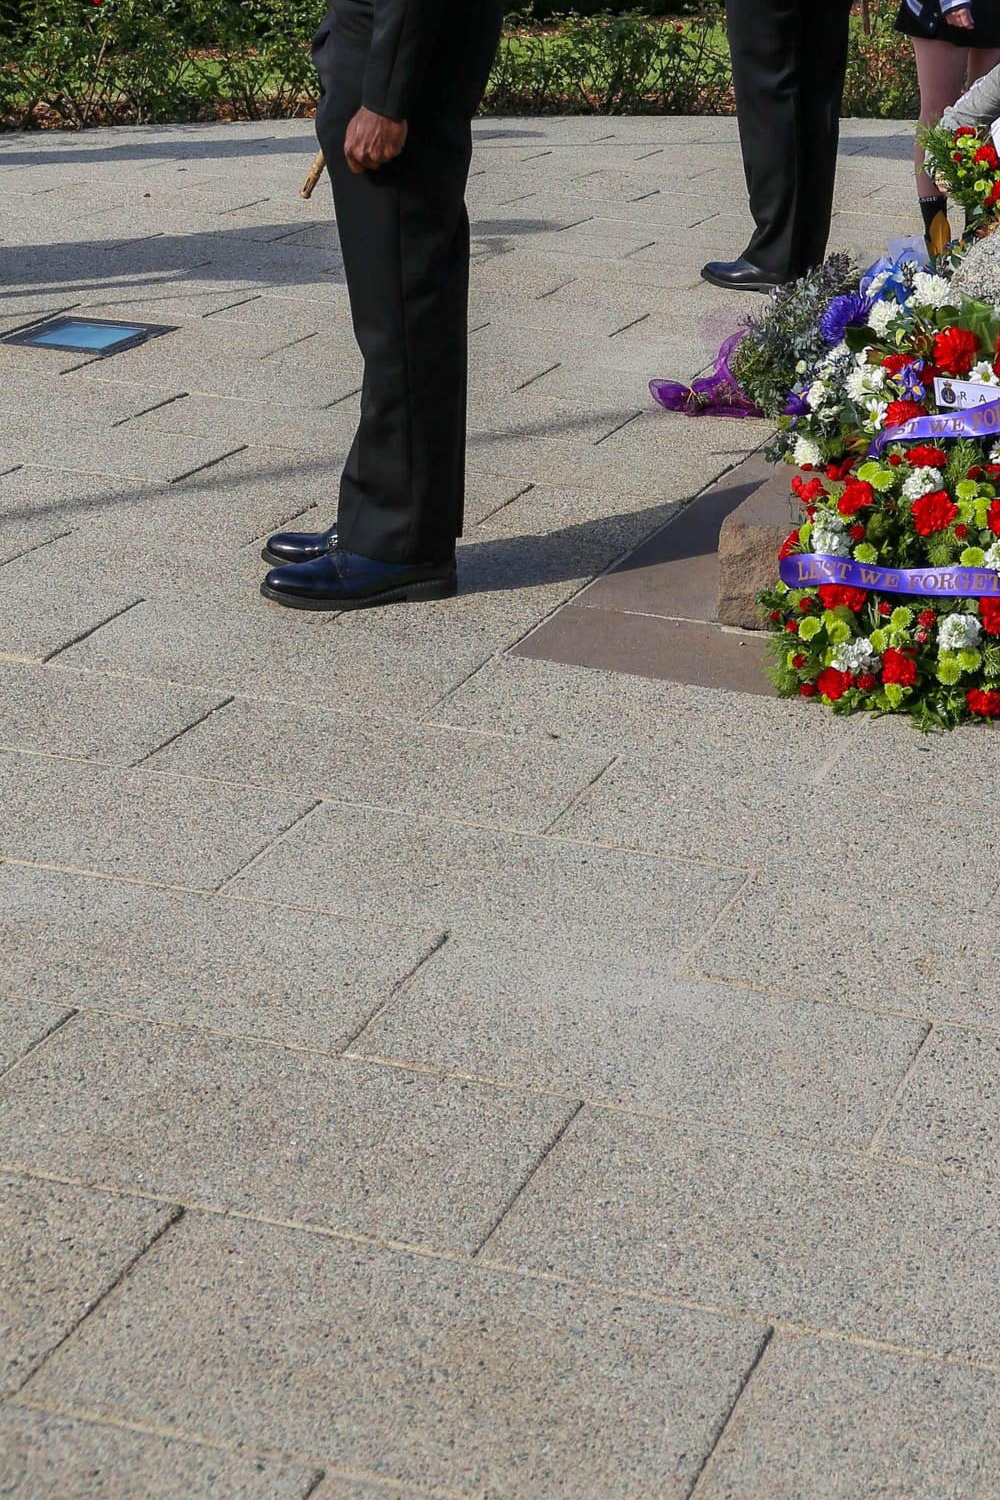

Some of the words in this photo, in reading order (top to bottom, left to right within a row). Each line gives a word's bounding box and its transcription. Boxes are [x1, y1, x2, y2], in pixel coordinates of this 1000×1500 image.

[928, 418, 966, 435] WE
[796, 559, 853, 582] LEST
[859, 568, 900, 588] WE
